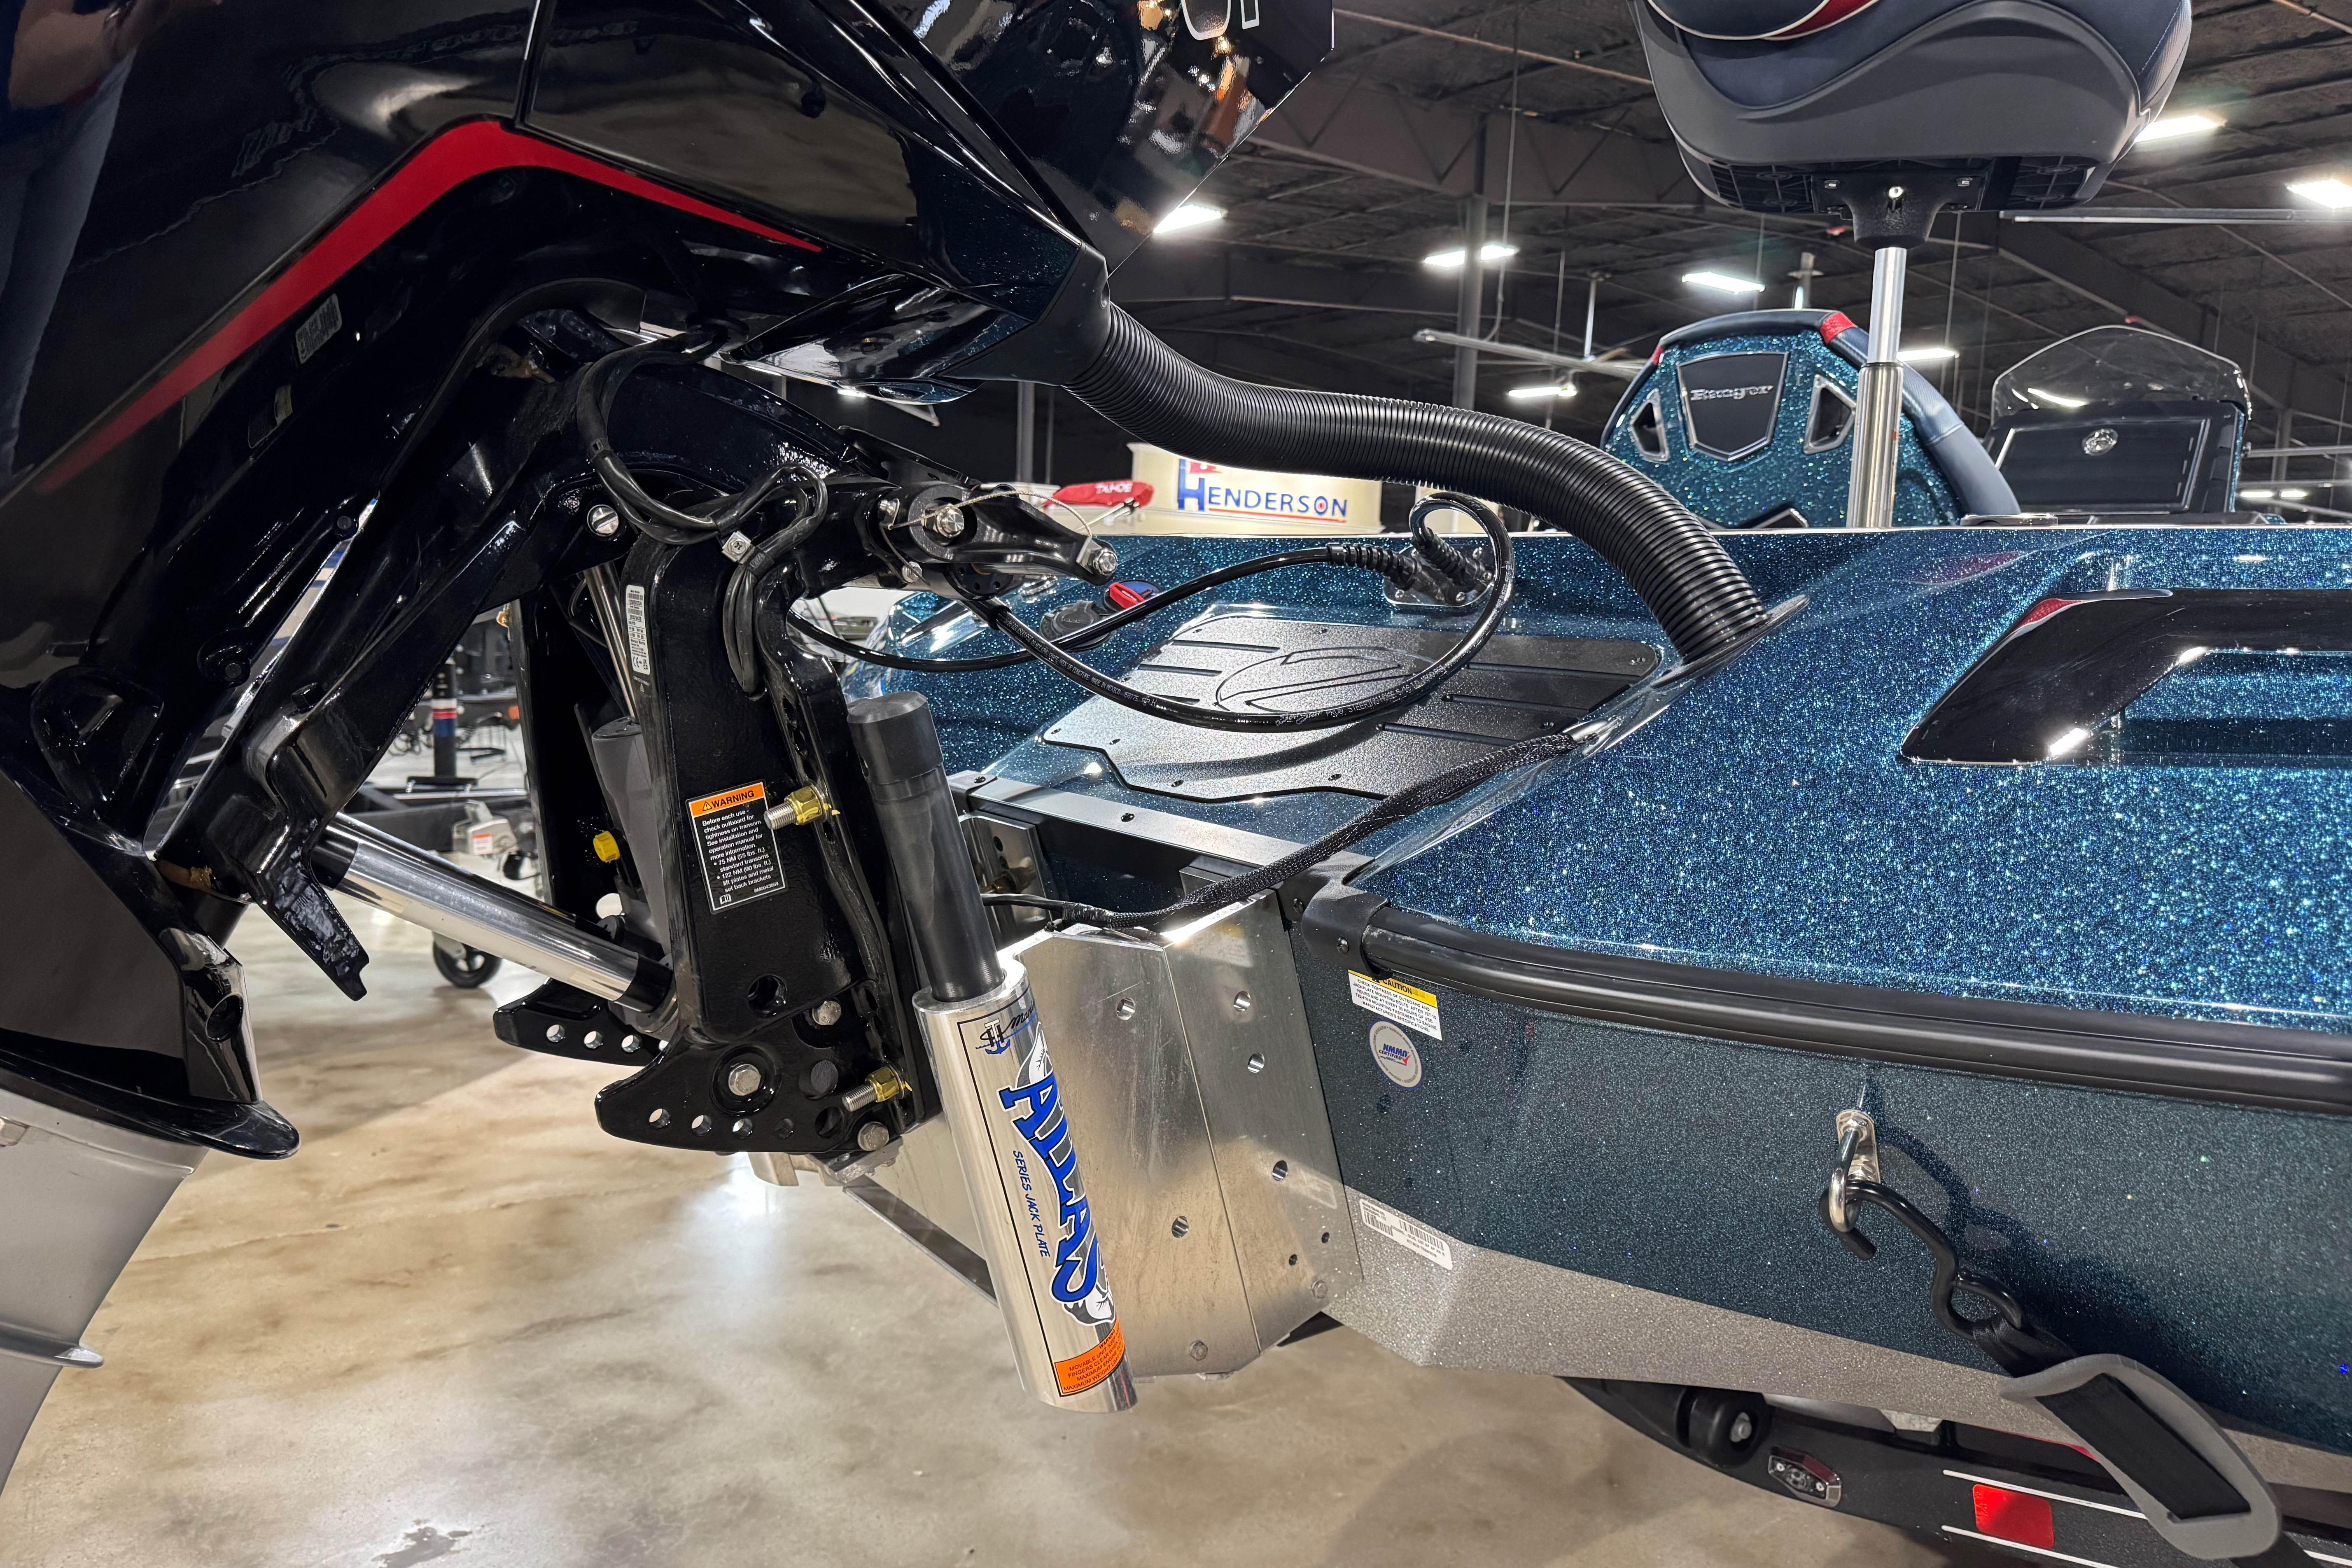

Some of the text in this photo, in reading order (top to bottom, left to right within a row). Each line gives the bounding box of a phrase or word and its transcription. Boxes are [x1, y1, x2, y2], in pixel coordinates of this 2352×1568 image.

[1096, 482, 1133, 494] TAHOE
[1178, 458, 1347, 517] HENDERSON
[712, 790, 754, 808] WARNING
[702, 817, 720, 826] Before
[722, 818, 746, 828] outboard
[705, 830, 730, 840] tightness
[719, 831, 747, 843] installation
[709, 843, 734, 854] operation
[735, 836, 755, 845] manual
[726, 844, 757, 856] information.
[720, 854, 769, 873] standard transoms
[744, 866, 752, 874] (90
[731, 875, 747, 885] plates
[759, 866, 774, 874] metal
[734, 881, 747, 890] back
[749, 874, 771, 885] brackets
[1371, 984, 1392, 996] TIGHTNESS
[1399, 996, 1421, 1008] OUTBOARD
[1383, 980, 1412, 995] CAUTION
[1357, 989, 1370, 999] HOURS
[1385, 1000, 1398, 1009] EVERY
[1404, 1008, 1418, 1017] HOURS
[1375, 991, 1395, 1003] MOUNTING
[1356, 993, 1371, 1003] TIGHTEN
[1372, 1000, 1392, 1011] MOUNTING
[1393, 1008, 1415, 1021] FASTENERS
[1422, 1021, 1437, 1030] ENGINE
[1379, 1050, 1402, 1059] CERTIFIED
[997, 1072, 1099, 1303] ATLAS
[1013, 1150, 1050, 1257] SERIES JACK PLATE
[1068, 1364, 1093, 1377] FINGERS
[1094, 1352, 1109, 1367] CLEAR
[1069, 1356, 1095, 1371] MOVABLE
[1097, 1347, 1107, 1358] UNIT
[1064, 1378, 1091, 1391] MAXIMUM
[1092, 1364, 1111, 1381] WEIGHT
[1077, 1366, 1102, 1381] MAXIMUM
